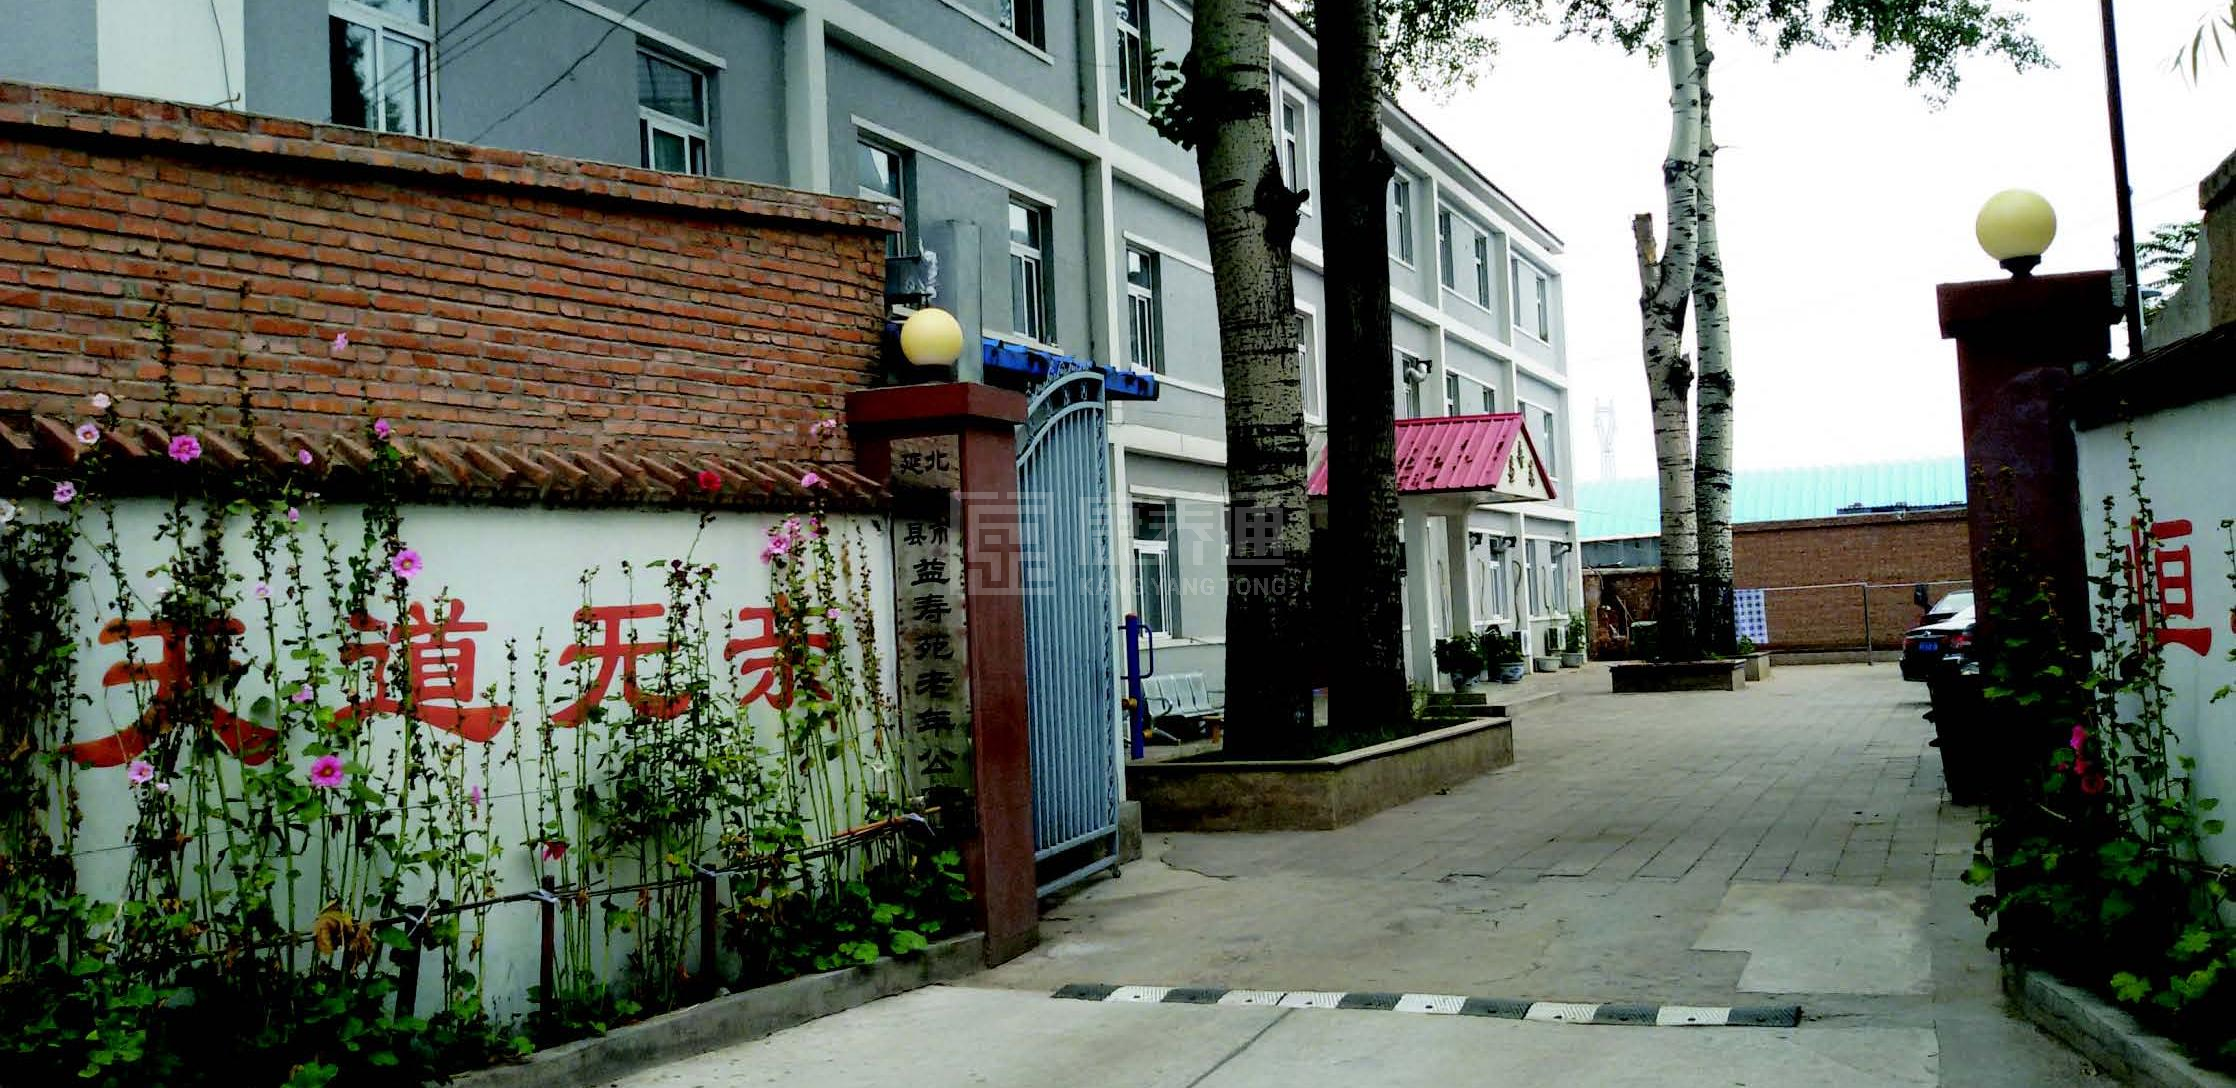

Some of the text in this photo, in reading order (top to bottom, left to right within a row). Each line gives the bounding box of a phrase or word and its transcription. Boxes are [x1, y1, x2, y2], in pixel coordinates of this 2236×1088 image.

[899, 452, 928, 547] 延县
[924, 449, 952, 547] 北市
[2124, 515, 2236, 660] 恒
[911, 557, 958, 802] 益寿苑老年公
